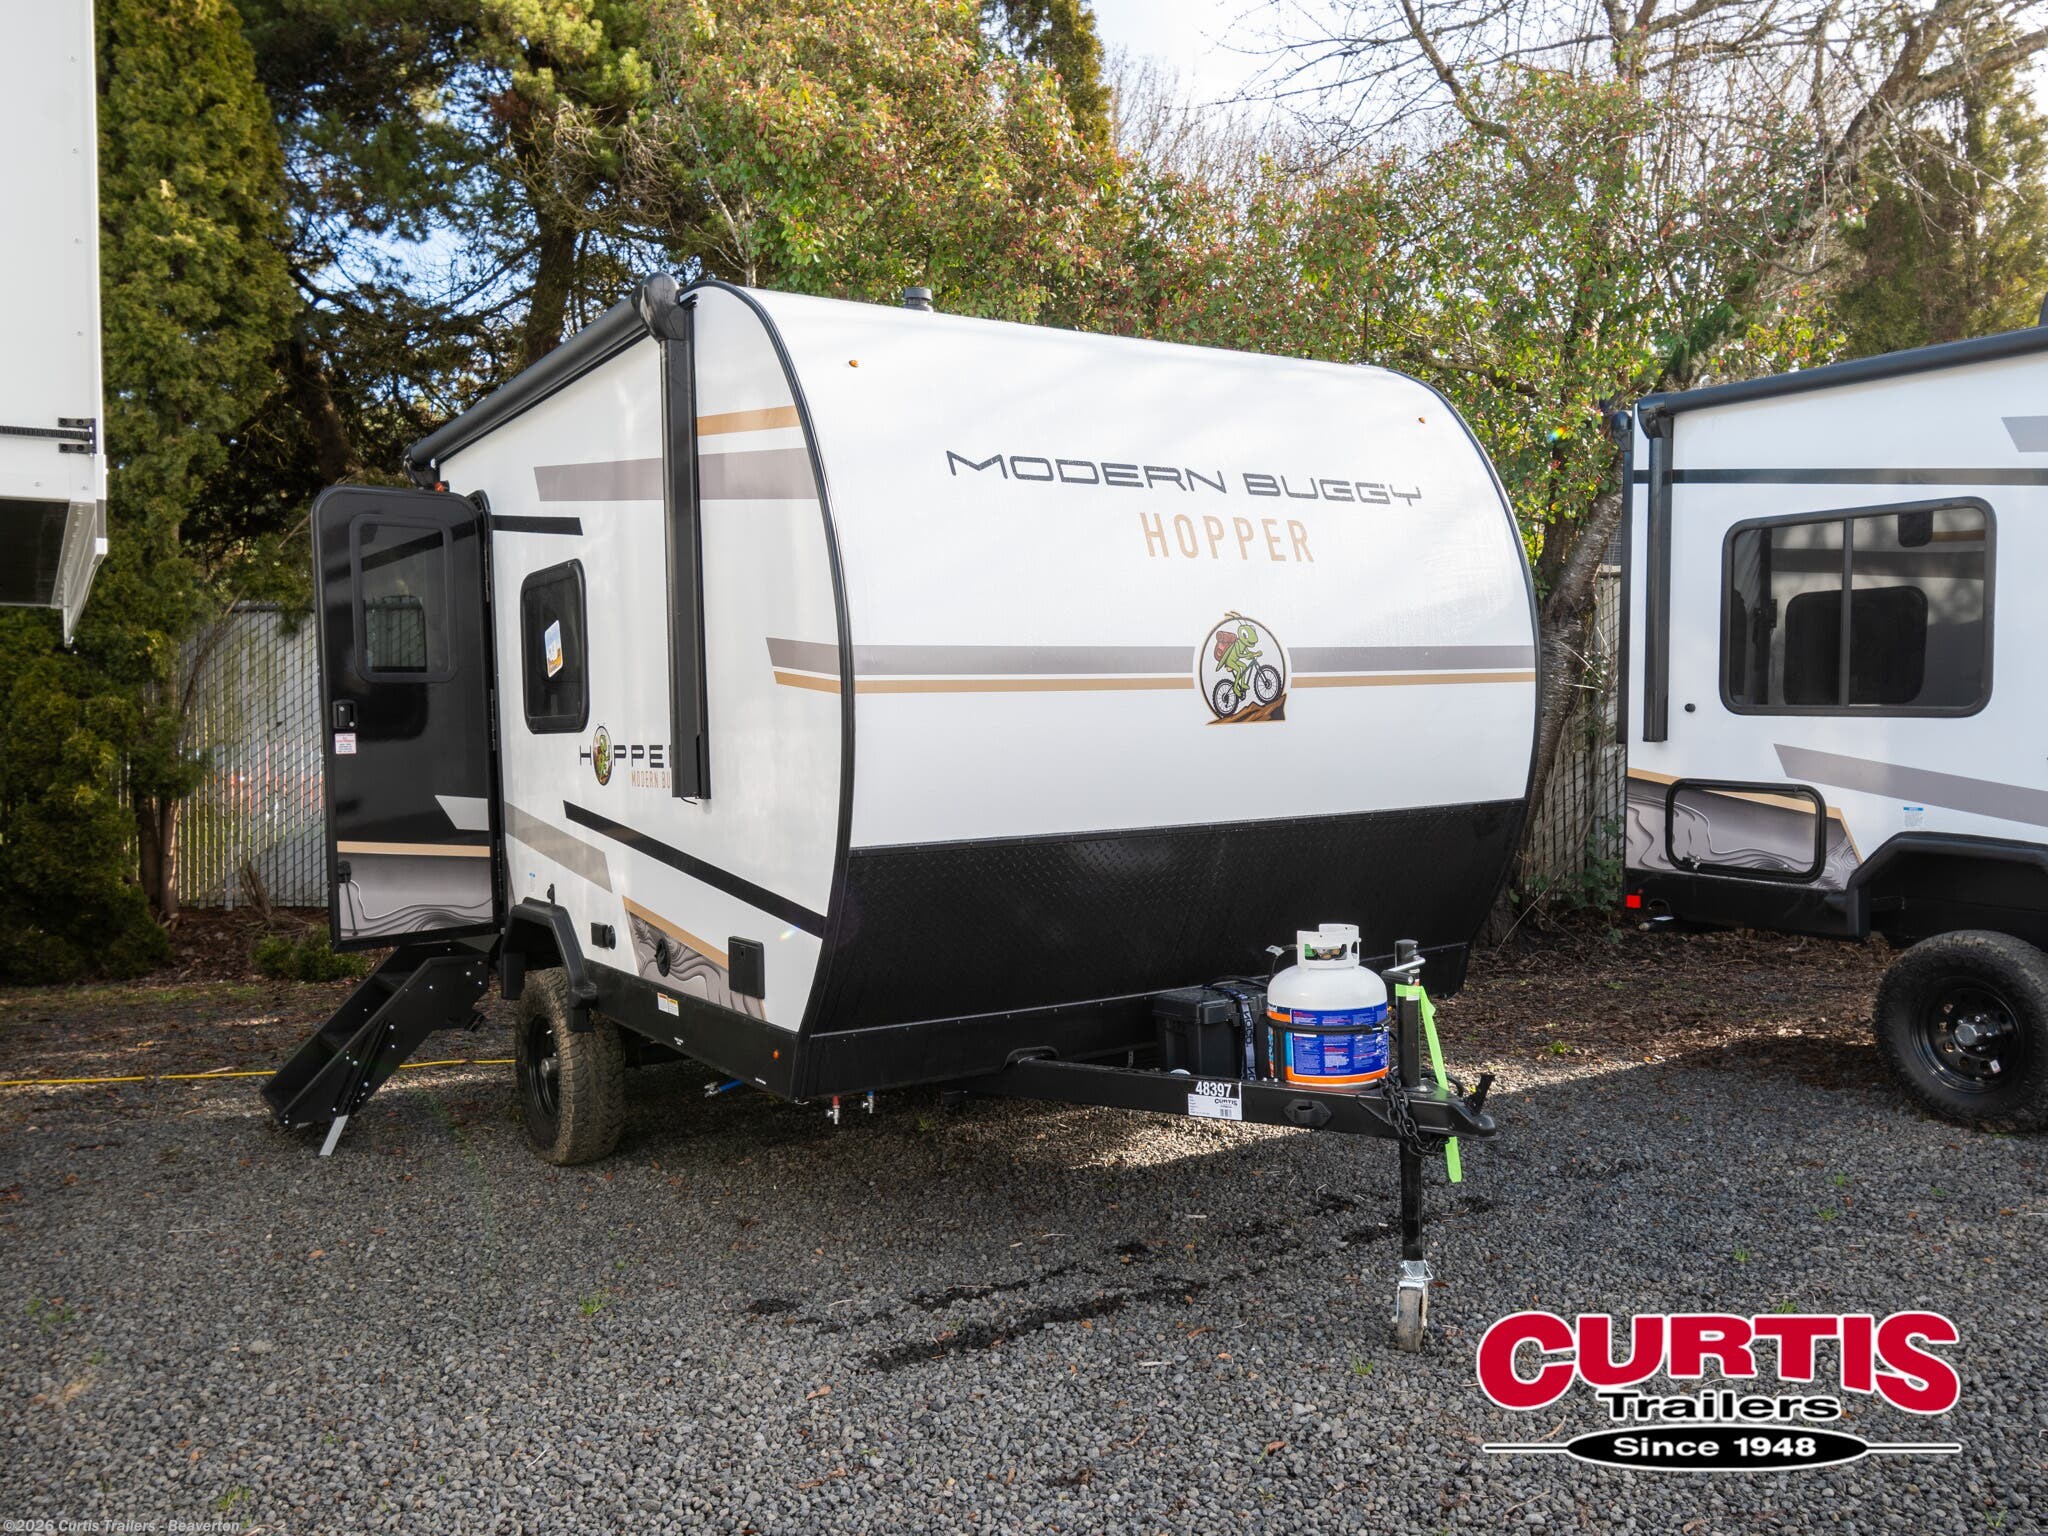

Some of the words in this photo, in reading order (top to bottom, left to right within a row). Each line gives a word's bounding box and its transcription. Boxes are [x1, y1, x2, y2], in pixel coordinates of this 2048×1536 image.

[946, 449, 1228, 495] MODERN
[1242, 472, 1423, 507] BUGGY
[1139, 511, 1315, 564] HOPPER
[631, 770, 659, 789] MODERN
[1195, 1080, 1232, 1098] 48397
[1214, 1098, 1238, 1107] CURTIS
